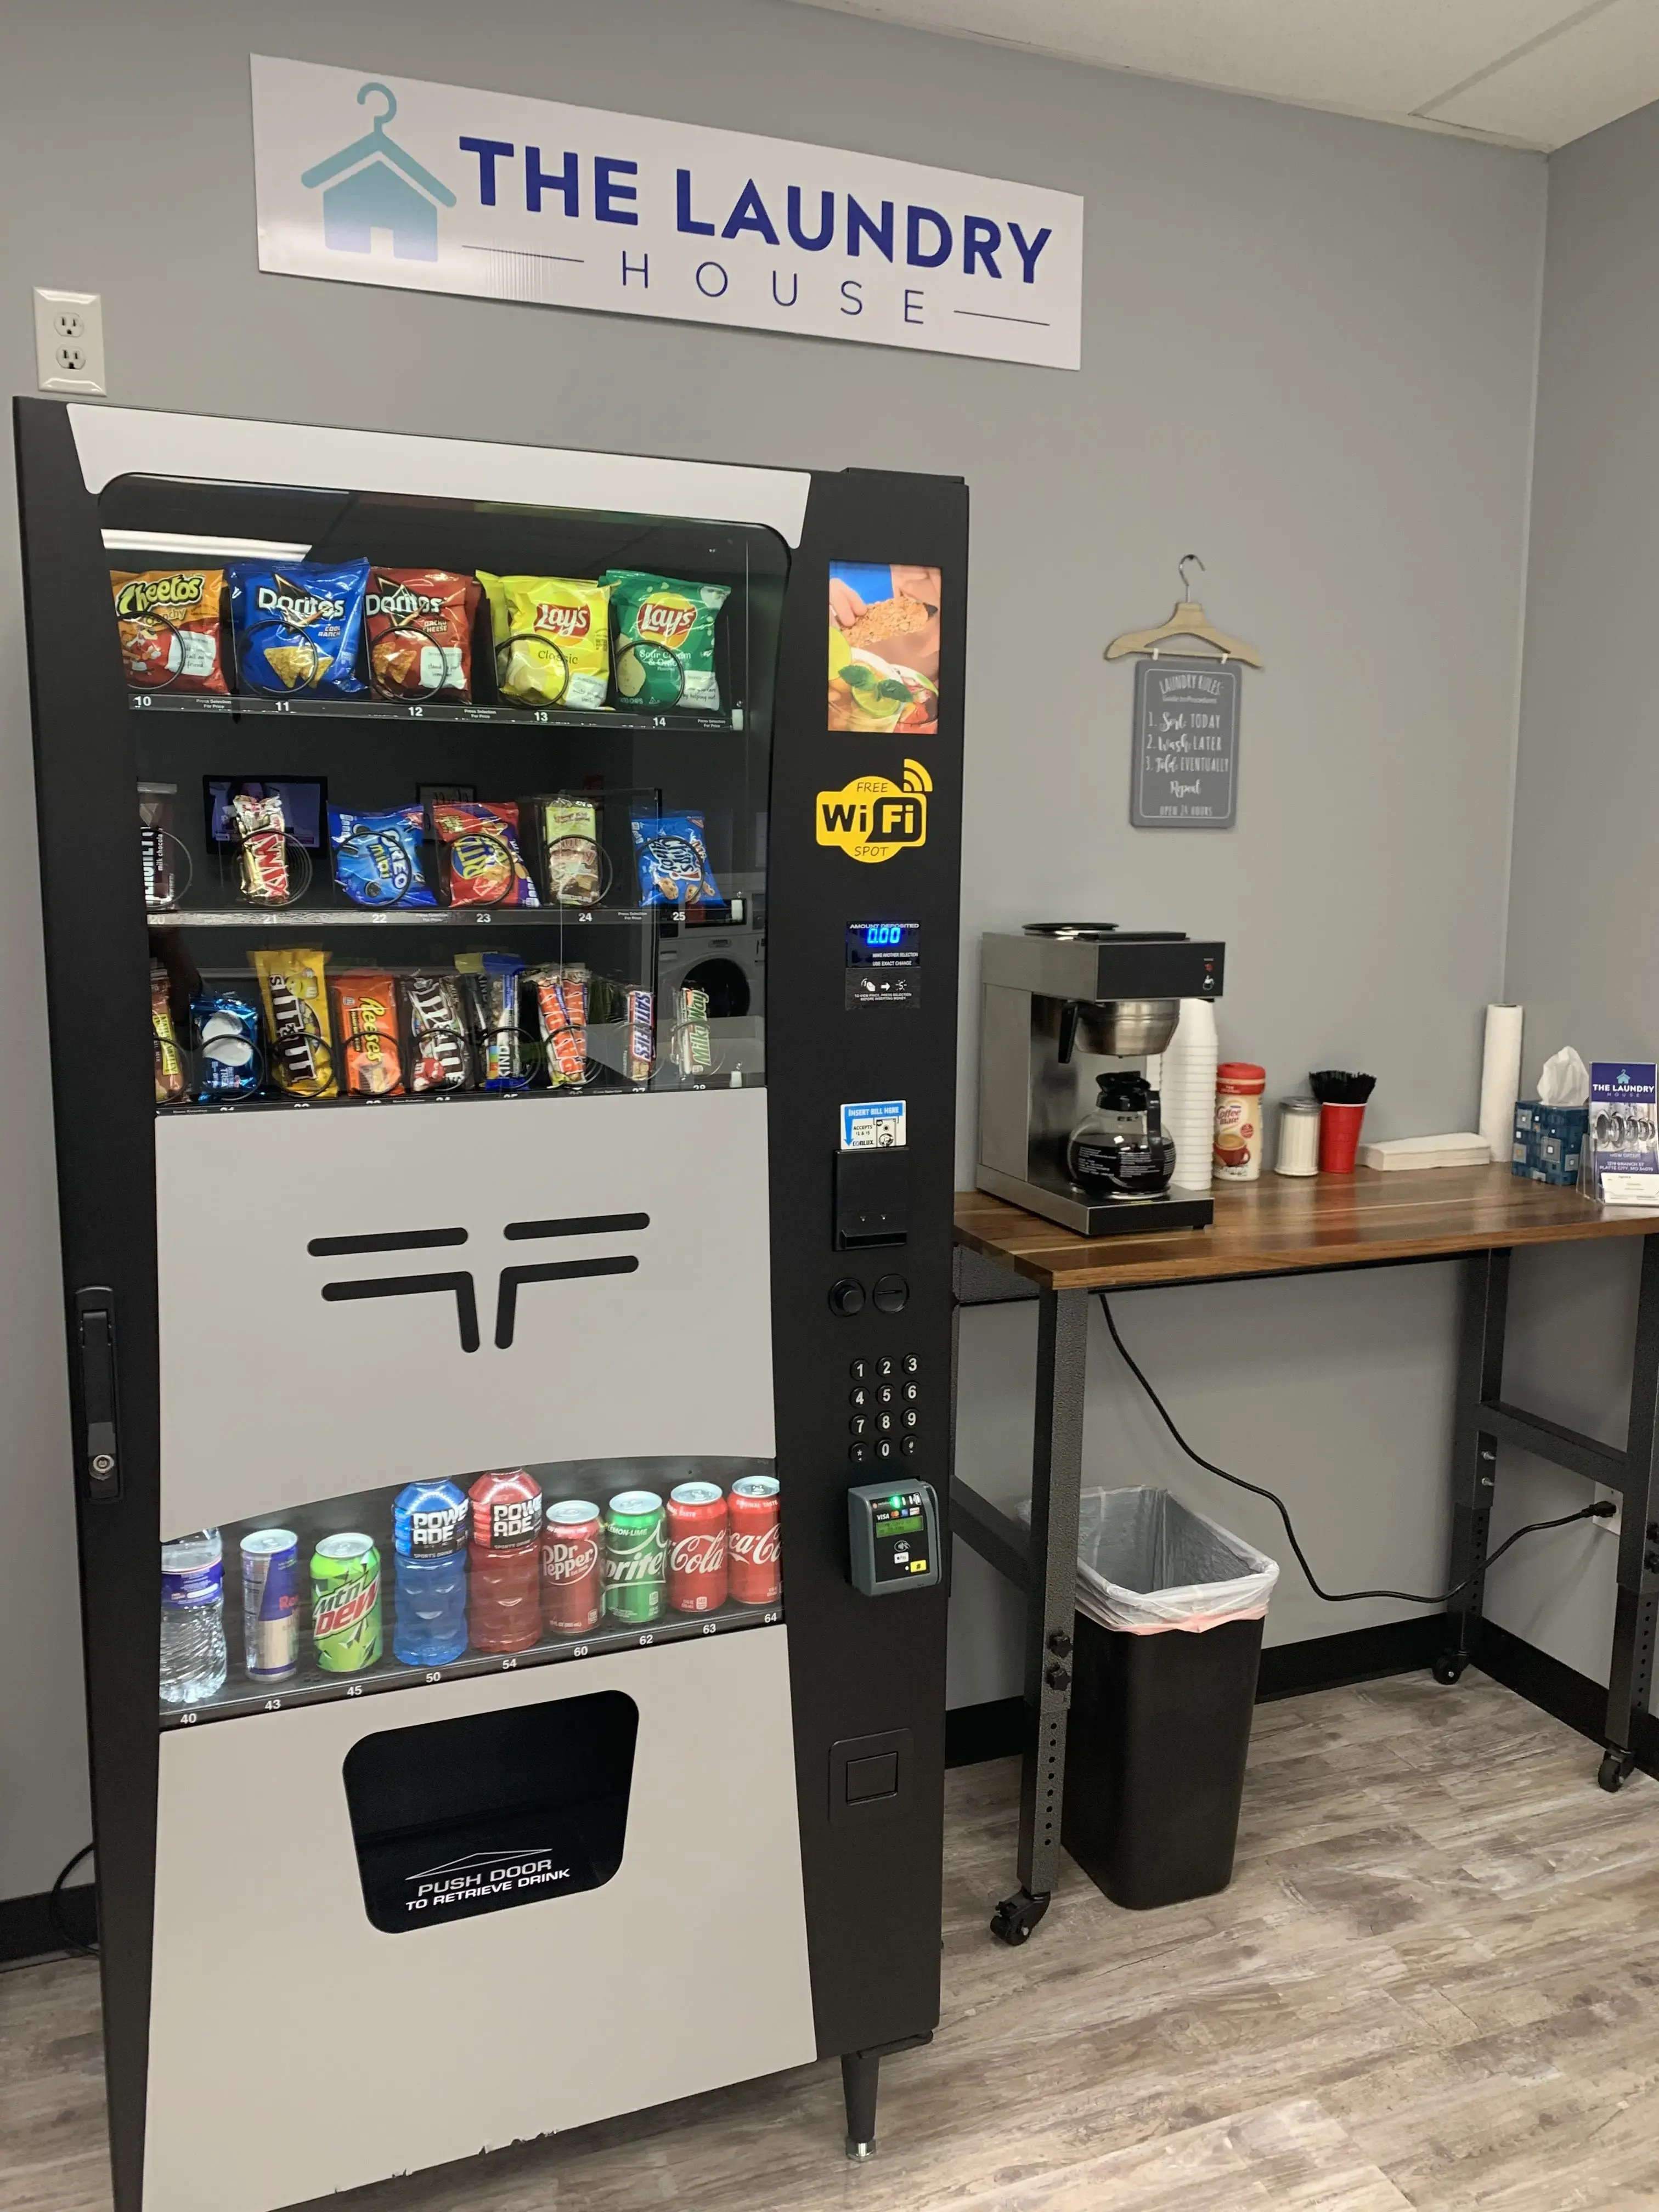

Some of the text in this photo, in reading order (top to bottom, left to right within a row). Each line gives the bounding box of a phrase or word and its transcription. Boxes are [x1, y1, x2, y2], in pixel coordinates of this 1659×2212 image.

[459, 135, 1052, 284] THE LAUNDRY
[620, 250, 926, 325] HOUSE
[117, 574, 204, 615] Cheetos
[258, 588, 345, 617] Doritos
[365, 594, 443, 616] Doritos
[534, 604, 588, 637] Lay's
[641, 604, 694, 637] Lay's
[1159, 674, 1197, 695] LAUNDRY
[137, 696, 152, 706] 10
[275, 701, 289, 711] 11
[408, 707, 424, 716] 12
[534, 712, 548, 721] 13
[653, 717, 666, 726] 14
[1190, 713, 1221, 729] TODAY
[1193, 735, 1222, 751] LATER
[1180, 757, 1229, 772] EVENTUALLY
[856, 782, 889, 793] FREE
[454, 836, 488, 879] RITZ
[854, 846, 889, 856] SPOT
[381, 829, 408, 889] OREO
[150, 916, 165, 924] 20
[263, 914, 277, 924] 21
[372, 913, 387, 923] 22
[476, 913, 492, 923] 23
[578, 912, 593, 922] 24
[673, 911, 686, 921] 25
[358, 996, 386, 1062] Reese's
[687, 989, 712, 1066] Milky Way
[498, 1044, 511, 1076] KIND
[1592, 1084, 1655, 1093] THE LAUNDRY
[848, 1109, 870, 1117] INSERT
[884, 1106, 900, 1114] HERE
[1216, 1105, 1242, 1119] Coffee
[856, 1357, 918, 1378] 1 2 3
[855, 1385, 917, 1405] 4 5 6
[856, 1412, 917, 1434] 7 8 9
[881, 1442, 890, 1457] 0
[413, 1497, 470, 1529] POWE
[493, 1516, 534, 1537] ADE
[607, 1525, 648, 1536] LEMON-LIME
[413, 1524, 455, 1545] ADE
[553, 1543, 579, 1563] Dr
[541, 1544, 594, 1581] Pepper
[606, 1551, 664, 1581] prite
[313, 1581, 362, 1617] Mtn
[764, 1612, 777, 1623] 64
[703, 1623, 716, 1634] 63
[639, 1634, 653, 1645] 62
[573, 1646, 589, 1657] 60
[502, 1658, 517, 1669] 54
[426, 1672, 441, 1683] 50
[347, 1685, 363, 1696] 45
[264, 1699, 281, 1710] 43
[180, 1713, 197, 1724] 40
[417, 1859, 553, 1897] PUSH DOOR
[405, 1868, 571, 1911] TO RETRIEVE DRINK
